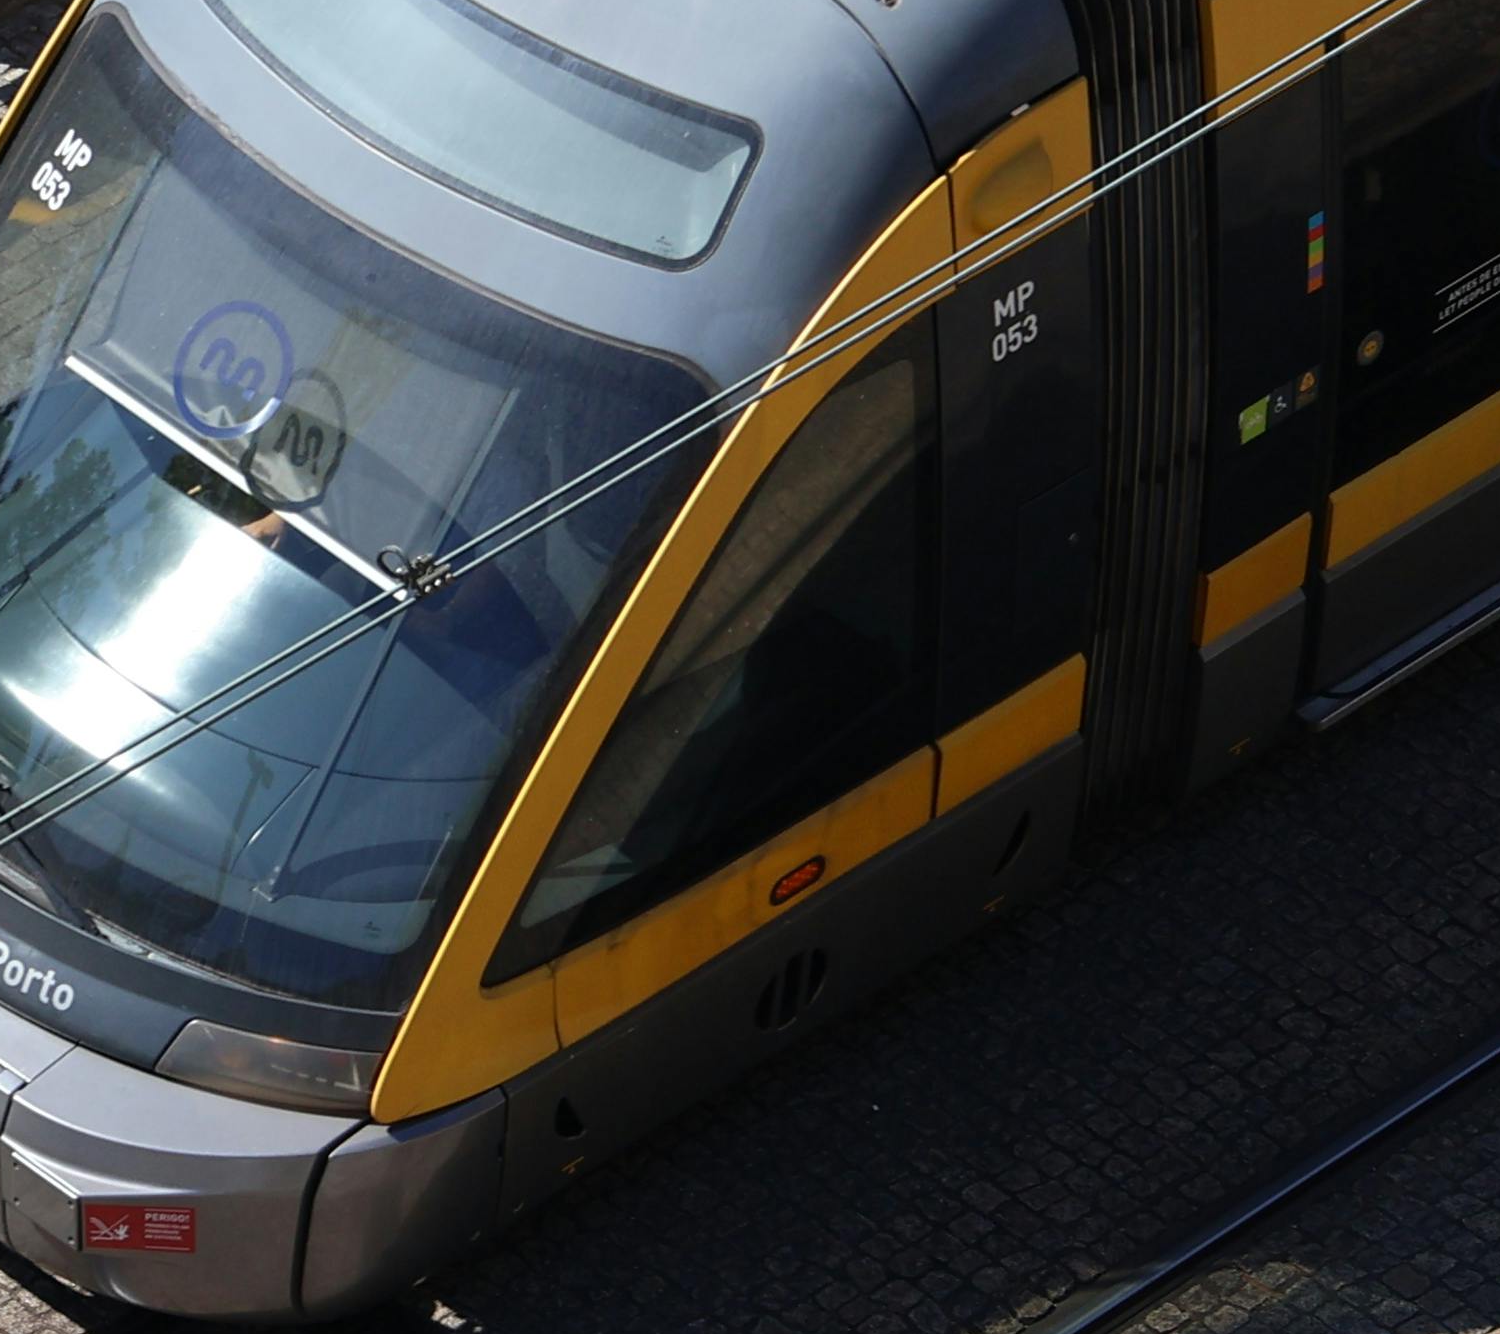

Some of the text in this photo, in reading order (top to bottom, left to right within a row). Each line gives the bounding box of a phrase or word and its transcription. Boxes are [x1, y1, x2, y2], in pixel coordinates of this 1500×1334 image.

[53, 128, 92, 171] MP
[31, 160, 71, 210] 053
[993, 280, 1035, 327] MP
[1438, 303, 1457, 321] LET
[1457, 281, 1492, 309] PEOPLE
[1448, 278, 1478, 303] ANTES
[1478, 269, 1491, 284] DE
[992, 314, 1038, 362] 053
